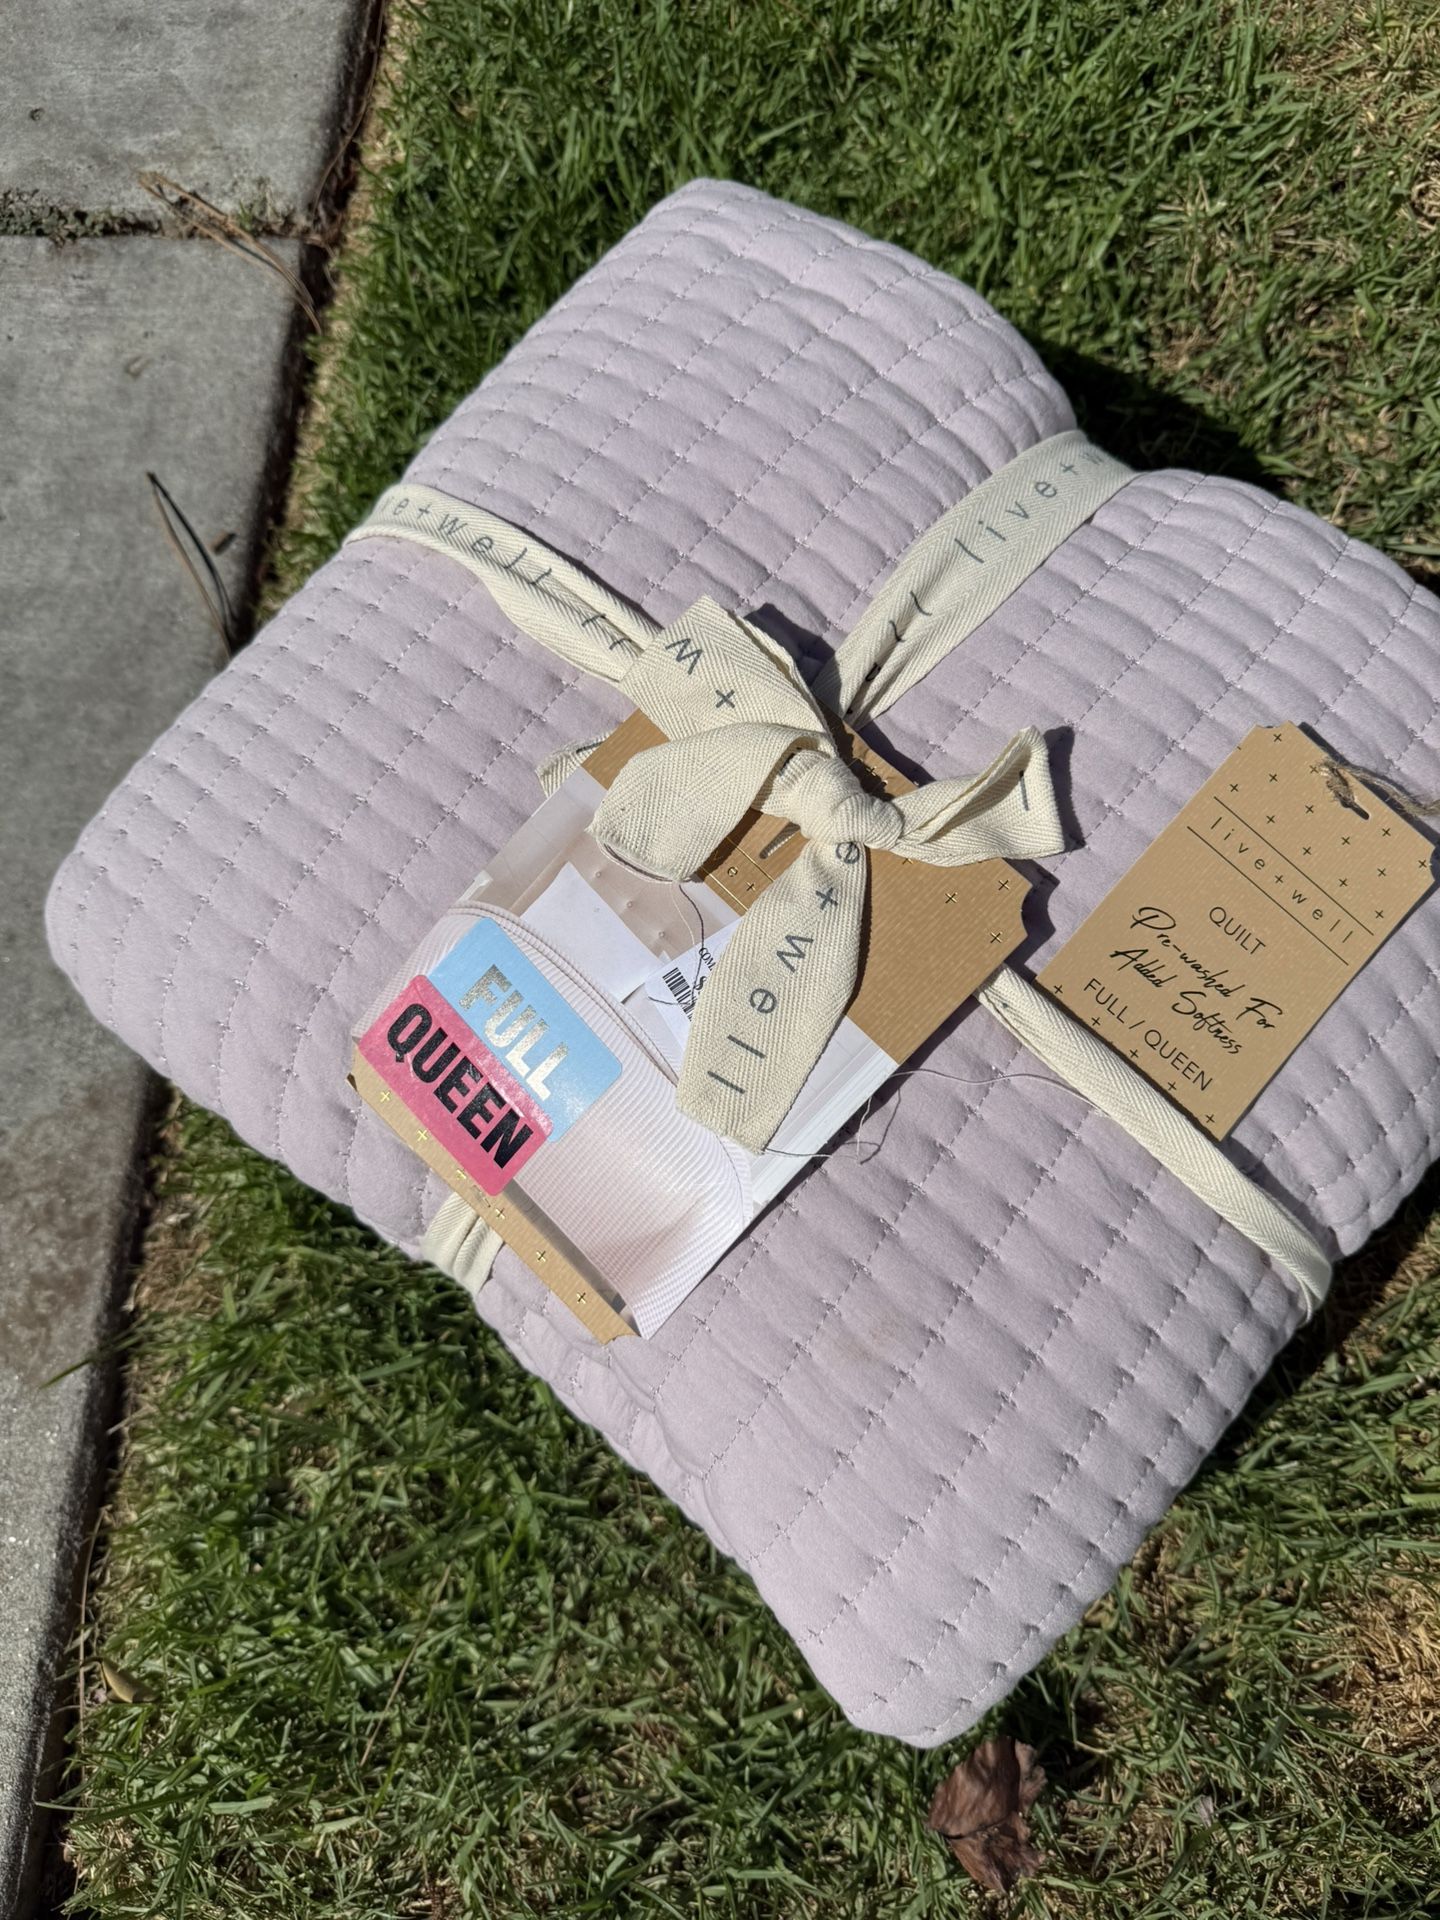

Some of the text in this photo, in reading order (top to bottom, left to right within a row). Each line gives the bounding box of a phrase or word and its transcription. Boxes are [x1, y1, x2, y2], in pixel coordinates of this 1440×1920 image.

[1208, 906, 1267, 956] QUILT
[1210, 816, 1354, 944] live+well
[1109, 948, 1243, 1055] Added Softness
[1130, 906, 1284, 1031] Pre-washed For
[387, 1003, 534, 1169] QUEEN
[458, 964, 569, 1101] FULL
[1083, 977, 1214, 1092] FULL / QUEEN
